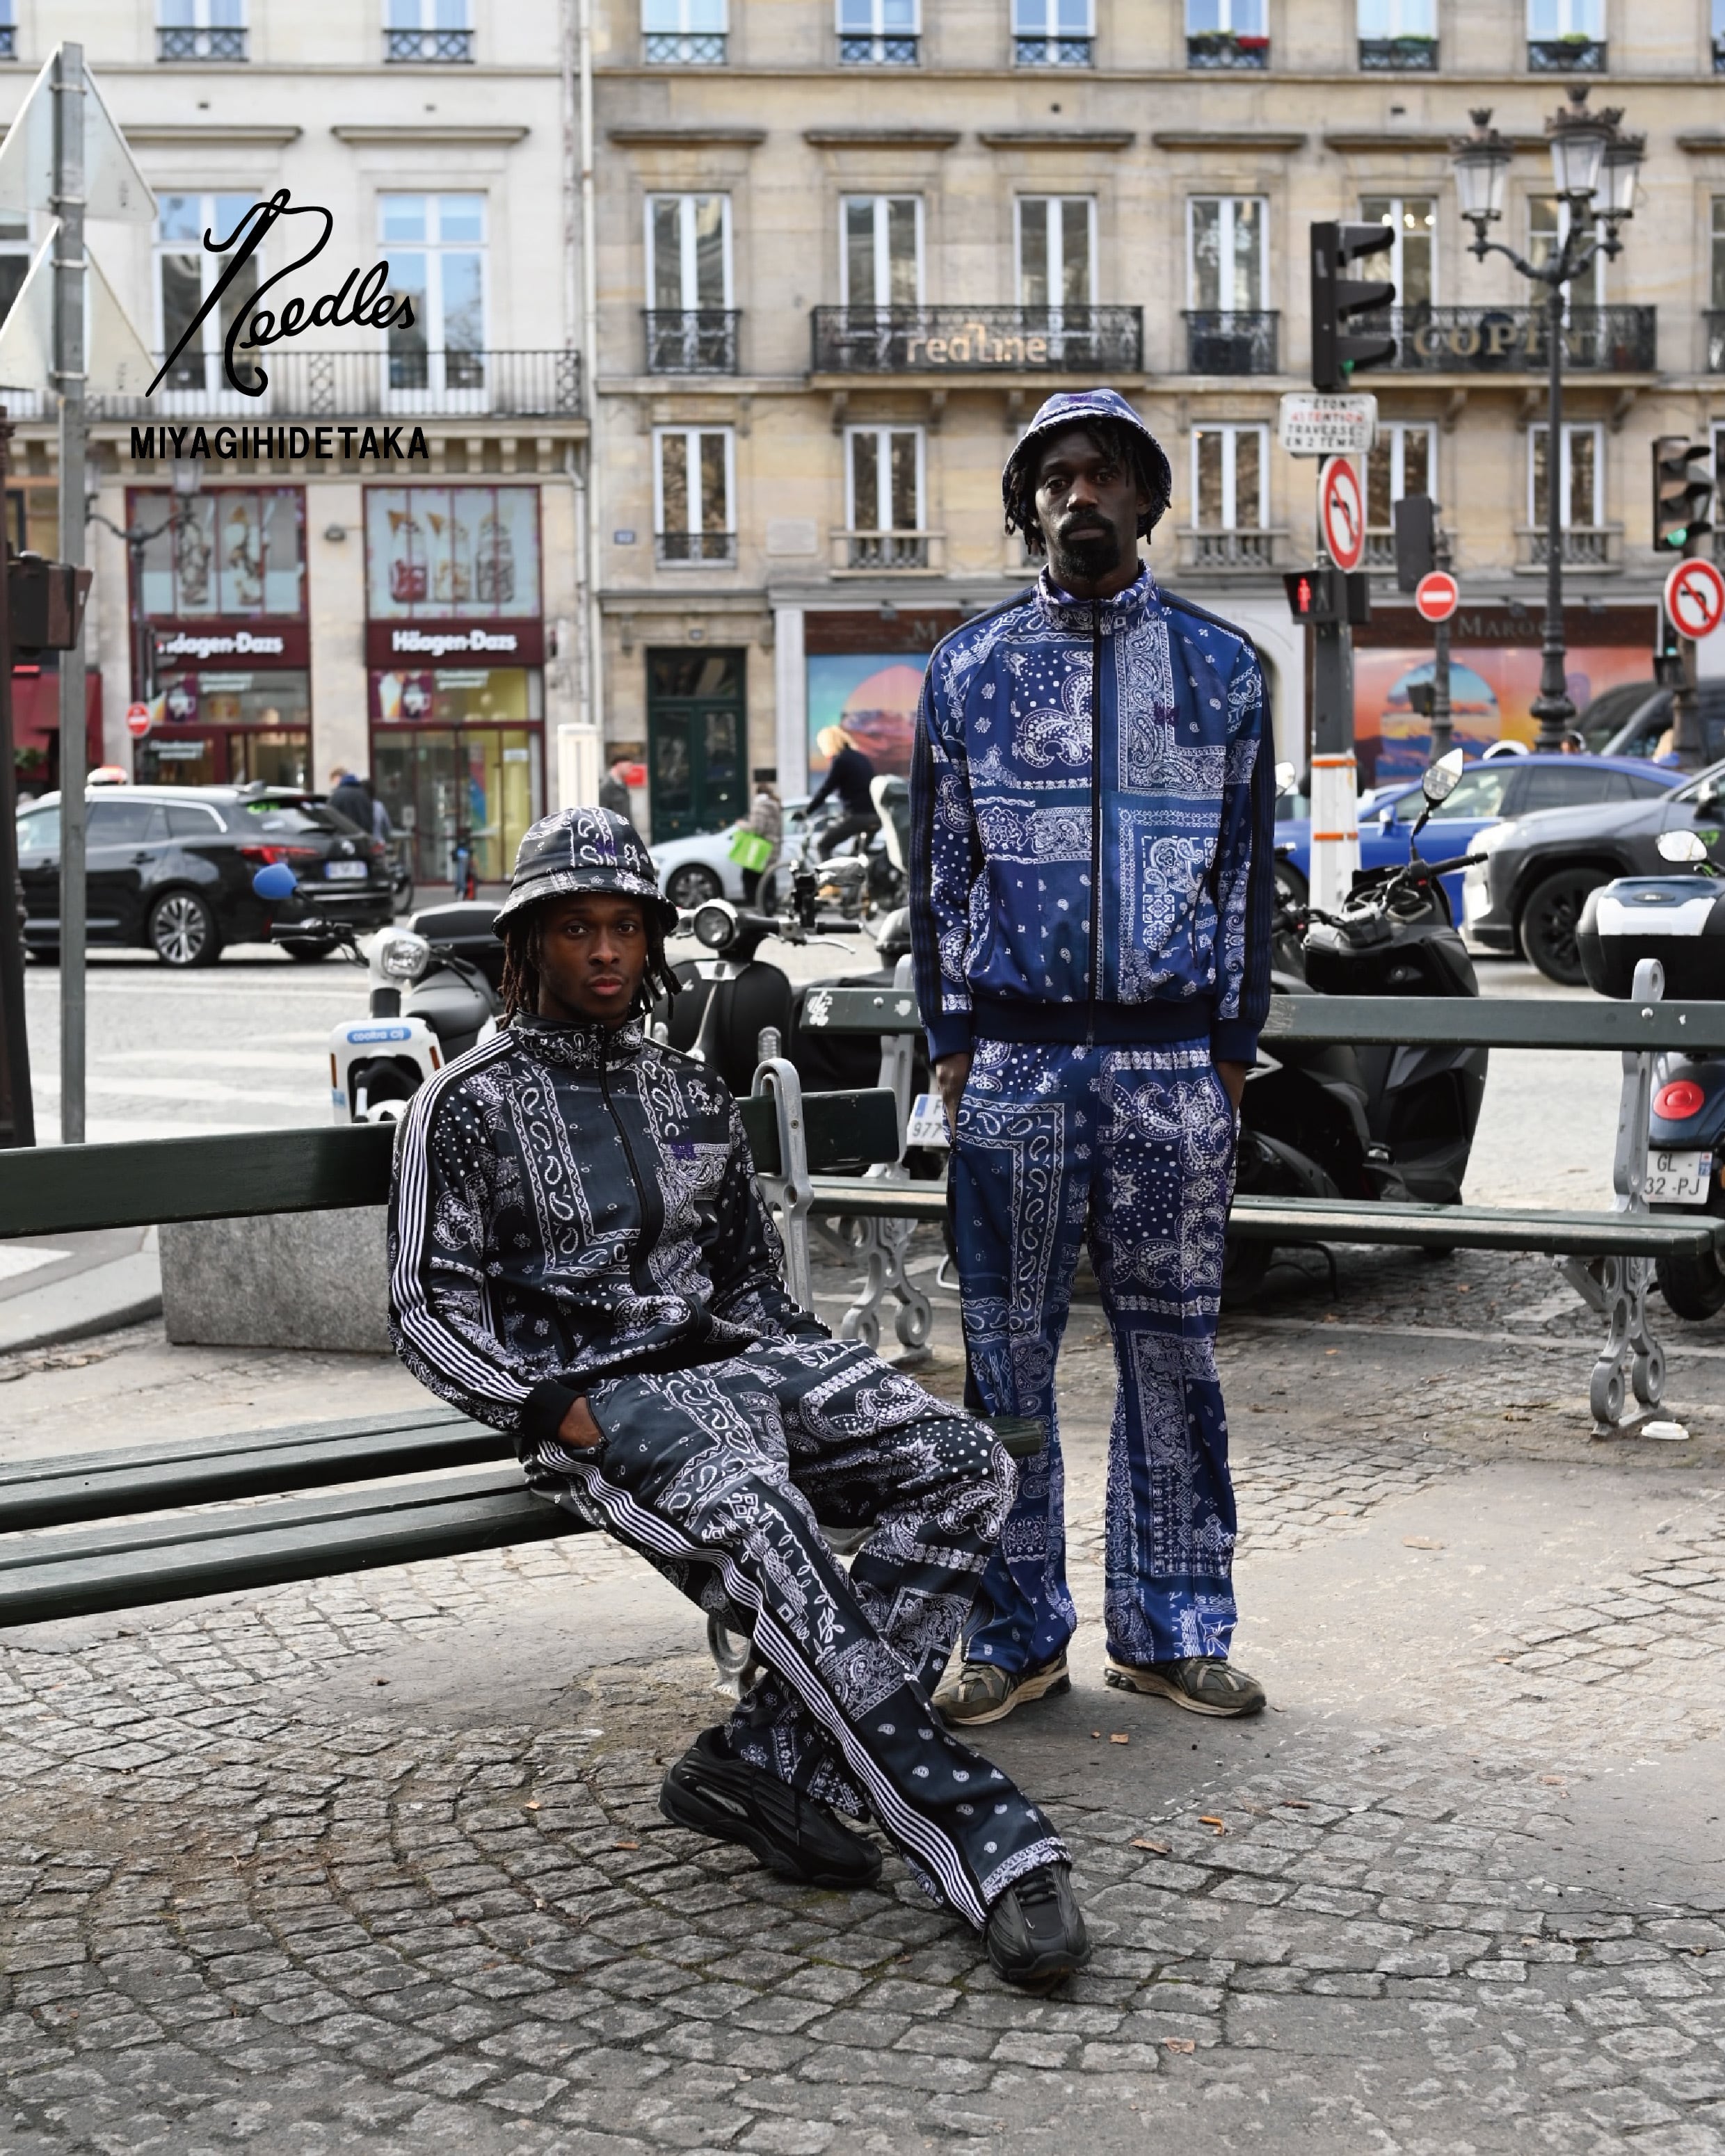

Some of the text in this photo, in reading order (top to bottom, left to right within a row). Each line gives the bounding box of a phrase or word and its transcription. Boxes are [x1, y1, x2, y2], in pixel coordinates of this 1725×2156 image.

[1321, 437, 1363, 447] TEMP
[392, 629, 518, 656] Häagen-Dazs
[1644, 1177, 1666, 1195] 32
